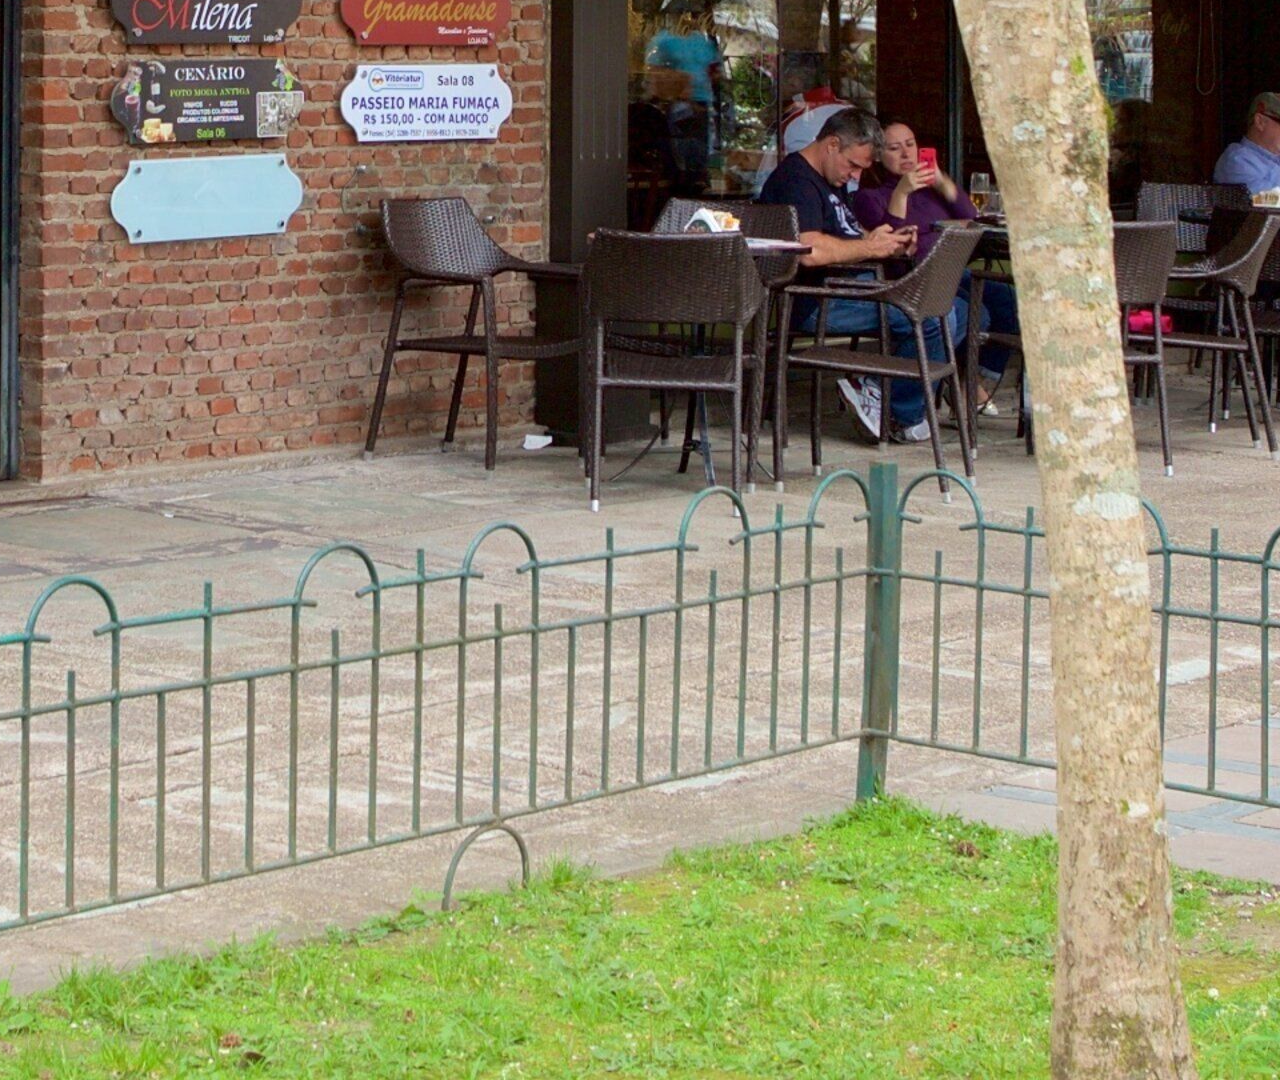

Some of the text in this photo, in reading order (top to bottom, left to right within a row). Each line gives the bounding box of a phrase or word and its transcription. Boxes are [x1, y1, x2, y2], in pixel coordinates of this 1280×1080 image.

[174, 64, 246, 82] CENÁRIO
[385, 73, 475, 87] Vitóriatur Sala 08
[169, 87, 251, 98] FOTO MODA ANTIGA
[351, 96, 500, 112] PASSEIO MARIA FUMAÇA
[363, 114, 376, 125] R$
[381, 113, 415, 126] 150,00
[424, 113, 445, 124] COM
[448, 112, 489, 126] ALMOÇO
[196, 128, 215, 138] Sala
